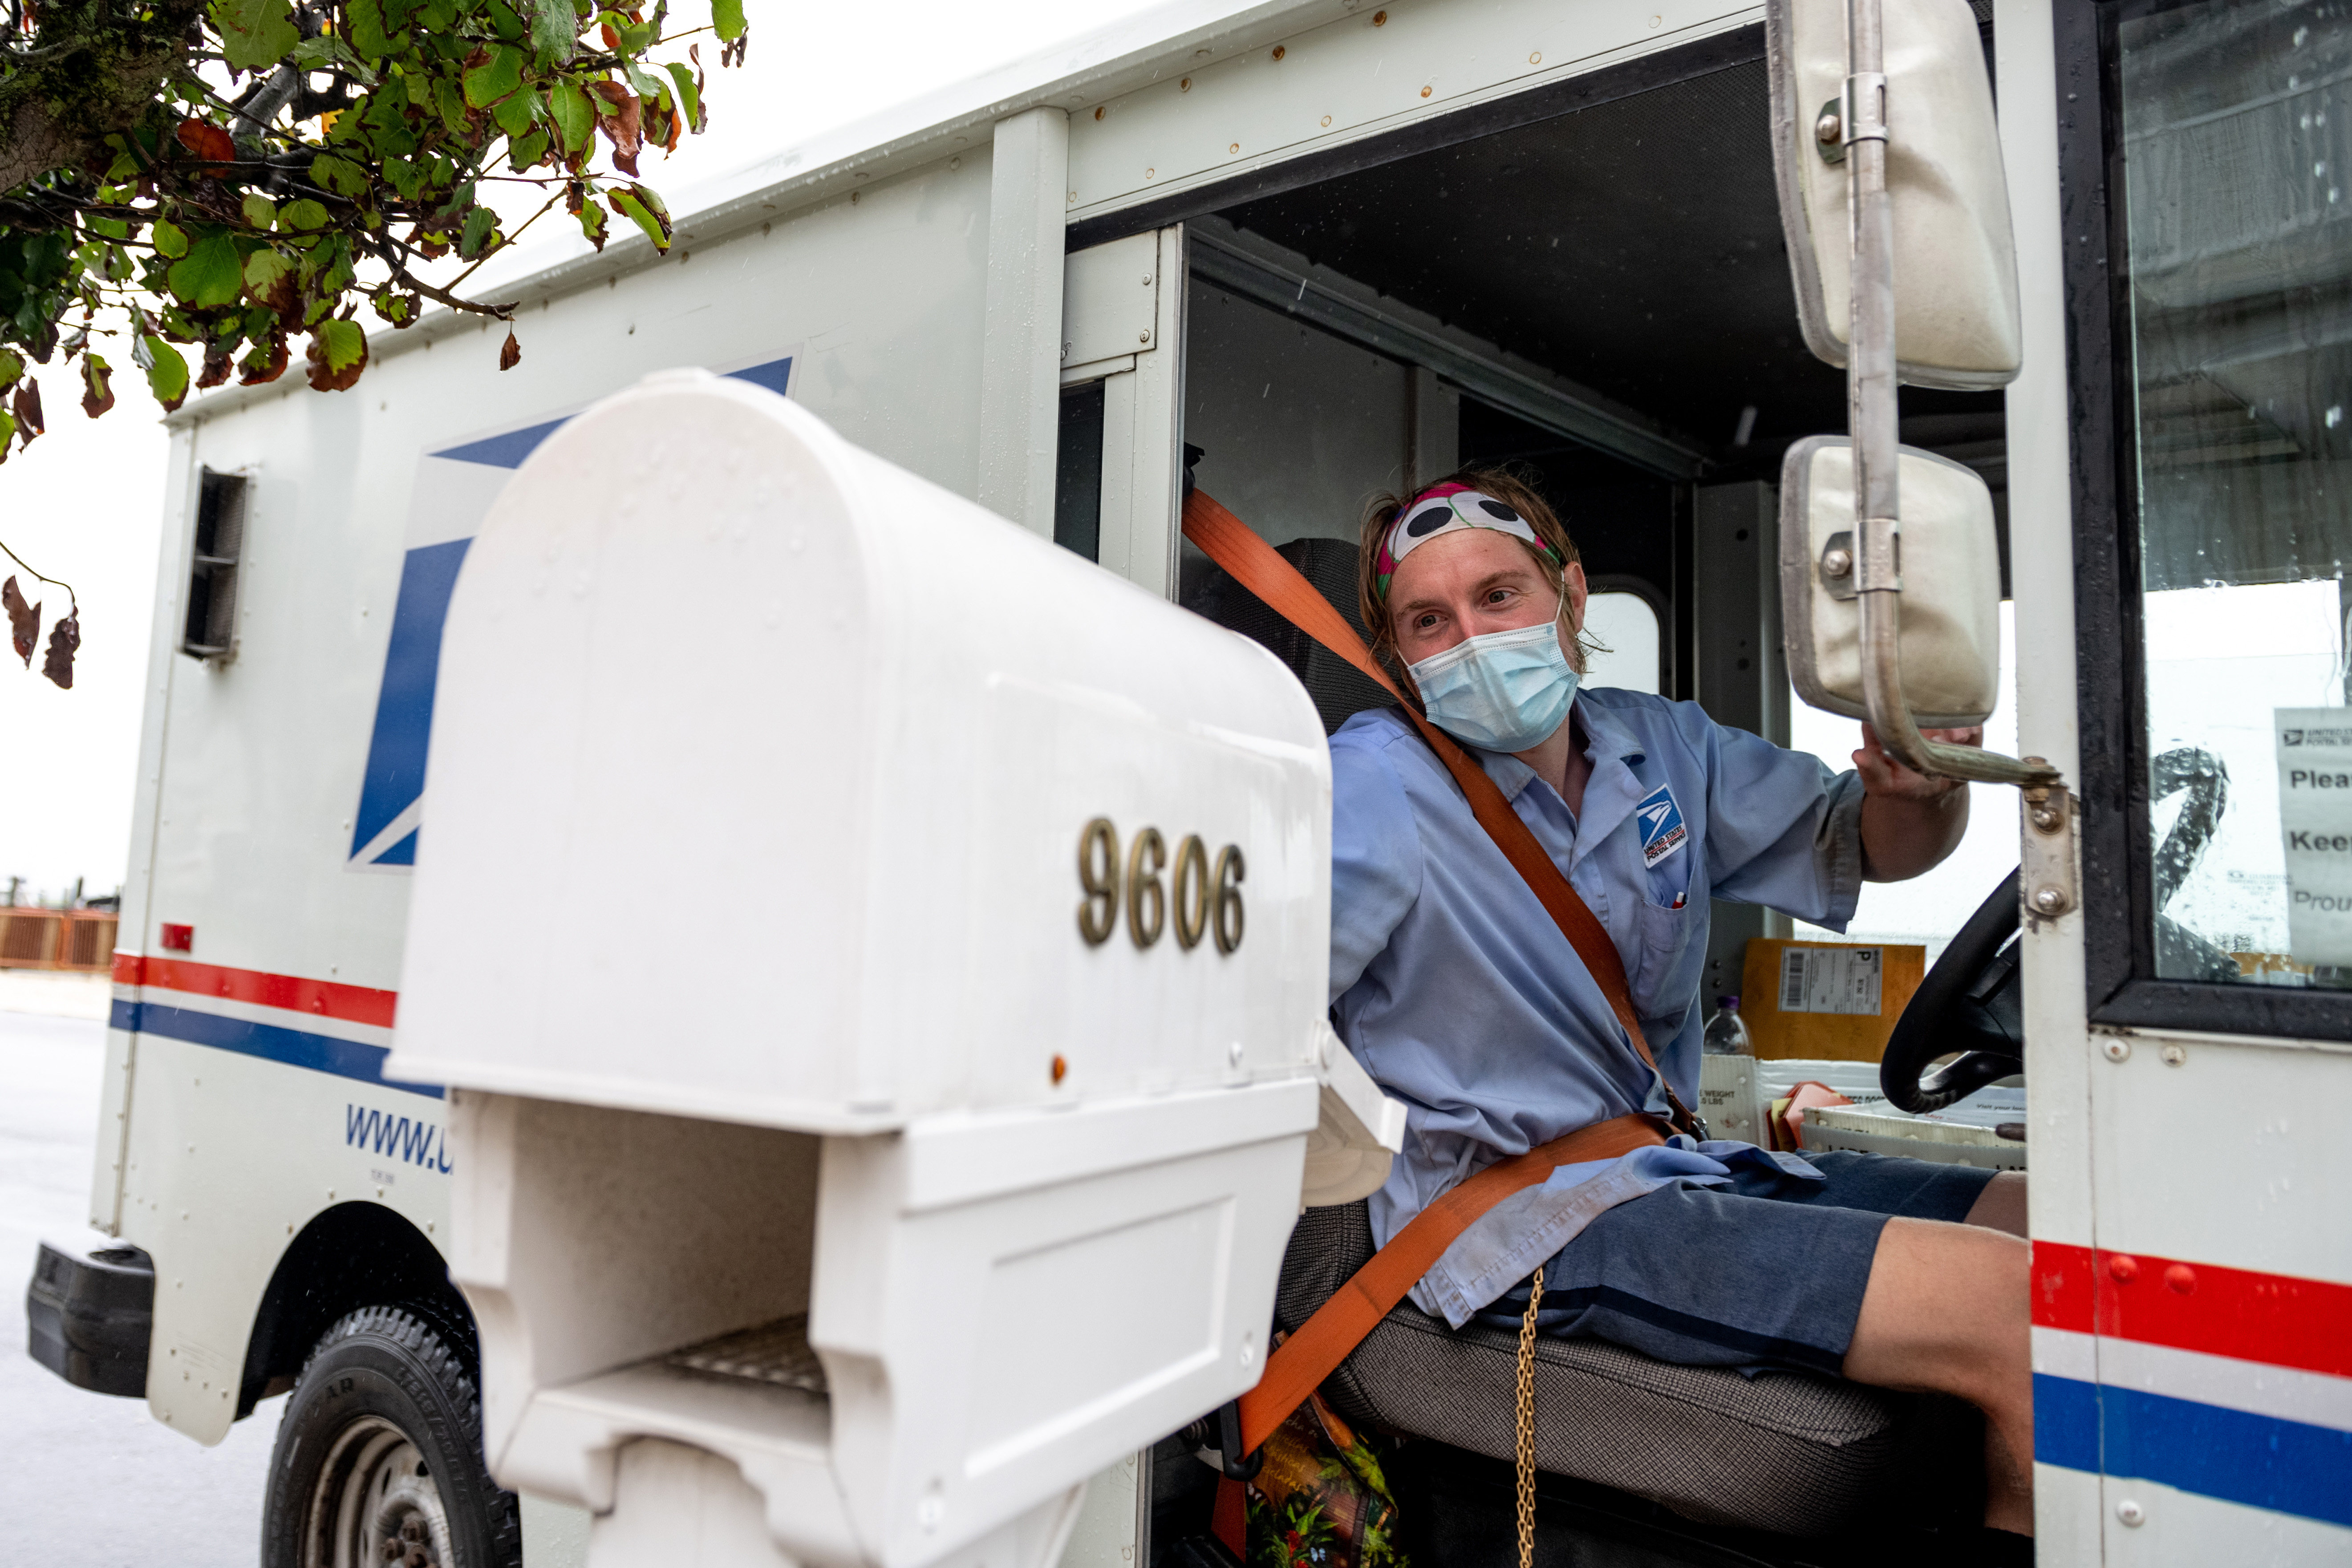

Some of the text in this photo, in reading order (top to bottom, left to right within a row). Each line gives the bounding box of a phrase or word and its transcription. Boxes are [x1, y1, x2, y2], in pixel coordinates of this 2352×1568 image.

[2291, 770, 2352, 789] Plea
[1644, 825, 1682, 854] UNITED STATES
[2291, 831, 2352, 855] Kee
[1647, 845, 1669, 862] POSTAL
[1077, 817, 1245, 956] 9606
[1705, 1090, 1735, 1098] WEIGHT
